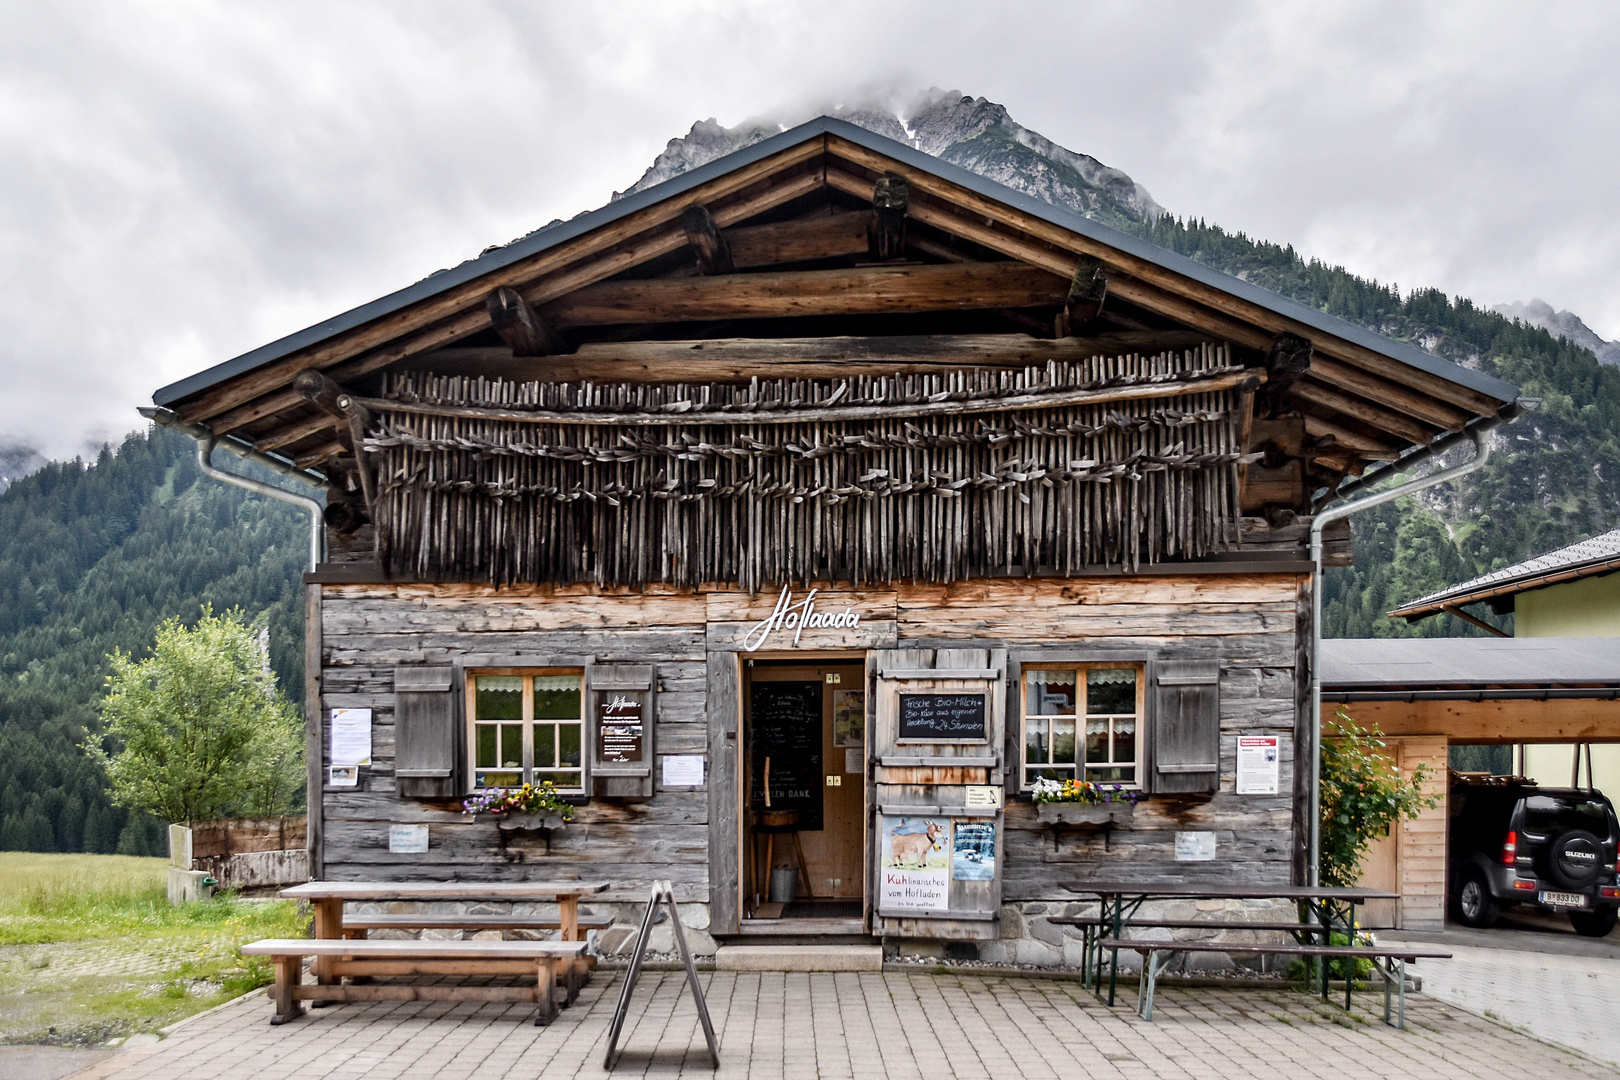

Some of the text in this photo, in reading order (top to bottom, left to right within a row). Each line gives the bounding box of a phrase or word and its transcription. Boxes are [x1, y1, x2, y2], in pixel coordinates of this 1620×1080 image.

[744, 583, 860, 651] Hoflaada
[904, 697, 931, 708] Frische
[951, 708, 977, 719] eigener
[948, 720, 983, 730] Stunden
[788, 789, 810, 798] DANK
[1565, 850, 1595, 859] SUZUKI
[888, 874, 945, 886] Kuhlinarisches
[905, 887, 941, 898] Hofladen
